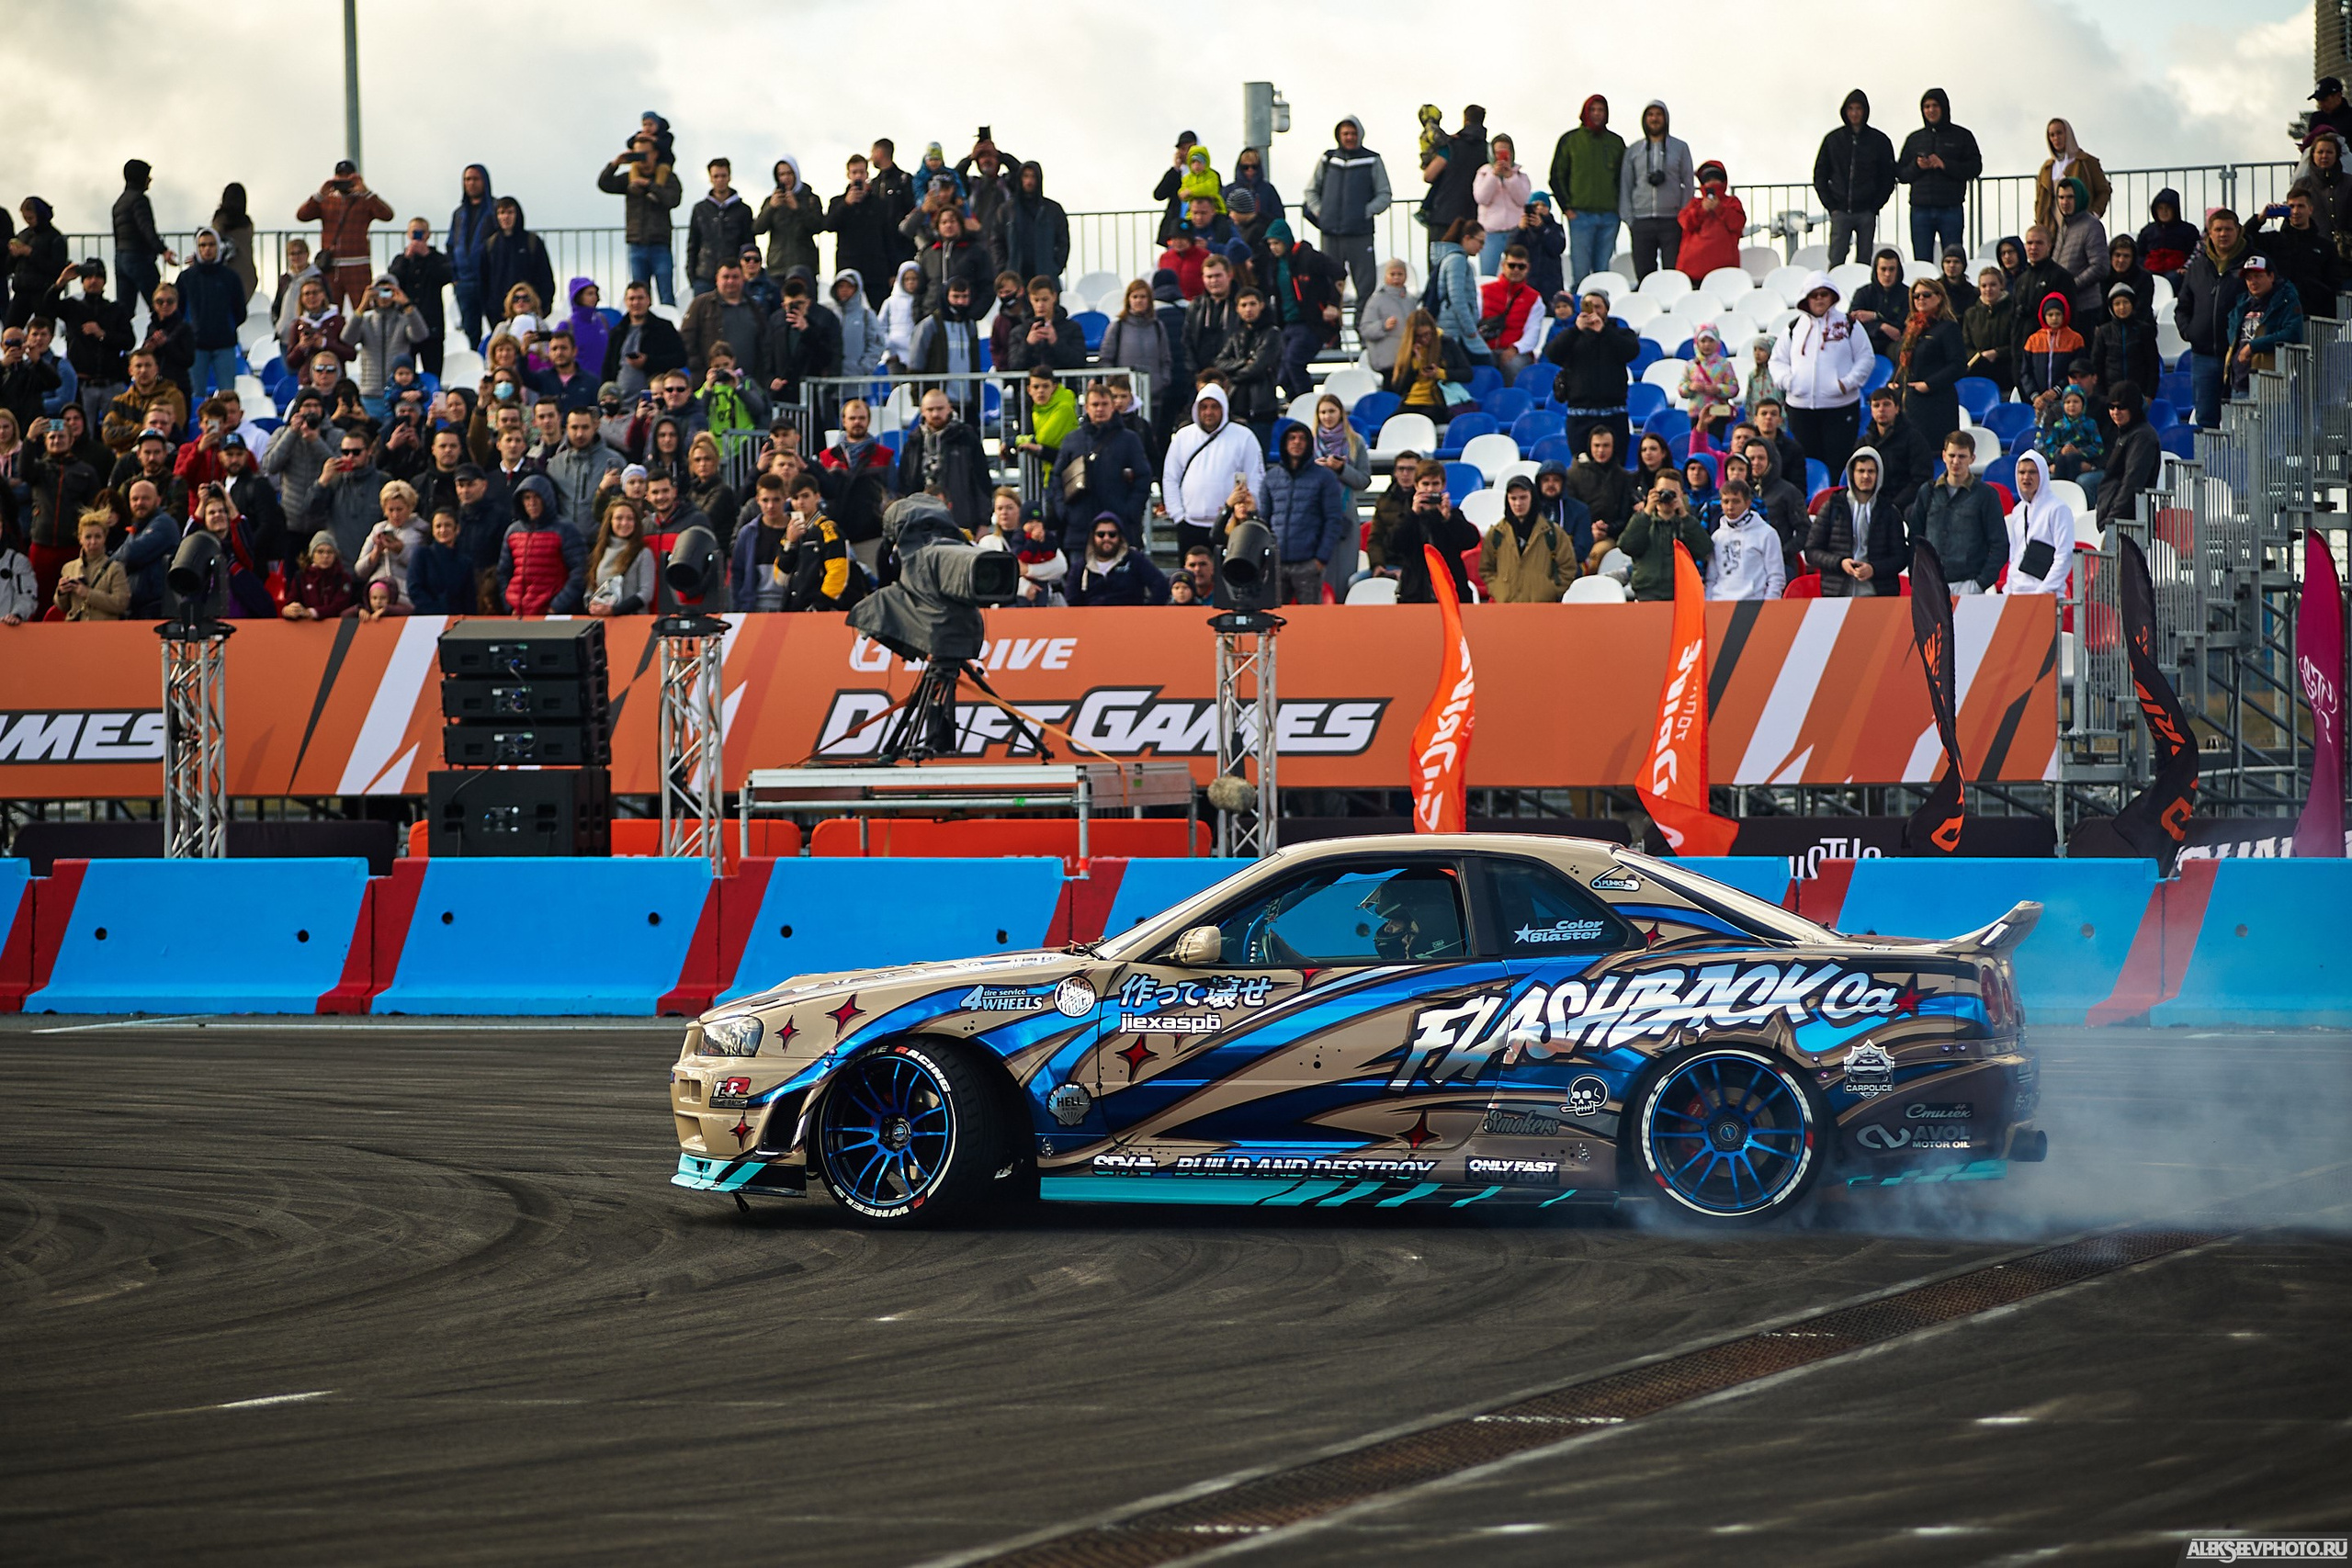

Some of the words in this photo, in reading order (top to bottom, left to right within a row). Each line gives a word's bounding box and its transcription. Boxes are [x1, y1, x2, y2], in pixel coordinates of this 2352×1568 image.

[0, 713, 164, 761] MES
[1555, 919, 1604, 931] Color
[1530, 931, 1601, 943] Blaster
[960, 984, 985, 1011] 4
[982, 997, 1044, 1010] WHEELS
[983, 988, 998, 997] tire
[999, 988, 1027, 997] service
[893, 1045, 952, 1093] RACING
[1845, 1084, 1894, 1093] CARPOLICE
[1056, 1096, 1083, 1108] HELL
[1483, 1110, 1561, 1135] Smokers
[1912, 1140, 1951, 1149] MOTOR
[1951, 1140, 1972, 1149] OIL
[1174, 1156, 1250, 1177] BUILD
[1250, 1157, 1310, 1178] AND
[1310, 1159, 1437, 1180] DESTROY
[1468, 1158, 1515, 1172] ONLY
[1513, 1160, 1558, 1173] FAST
[832, 1183, 910, 1218] WHEELS
